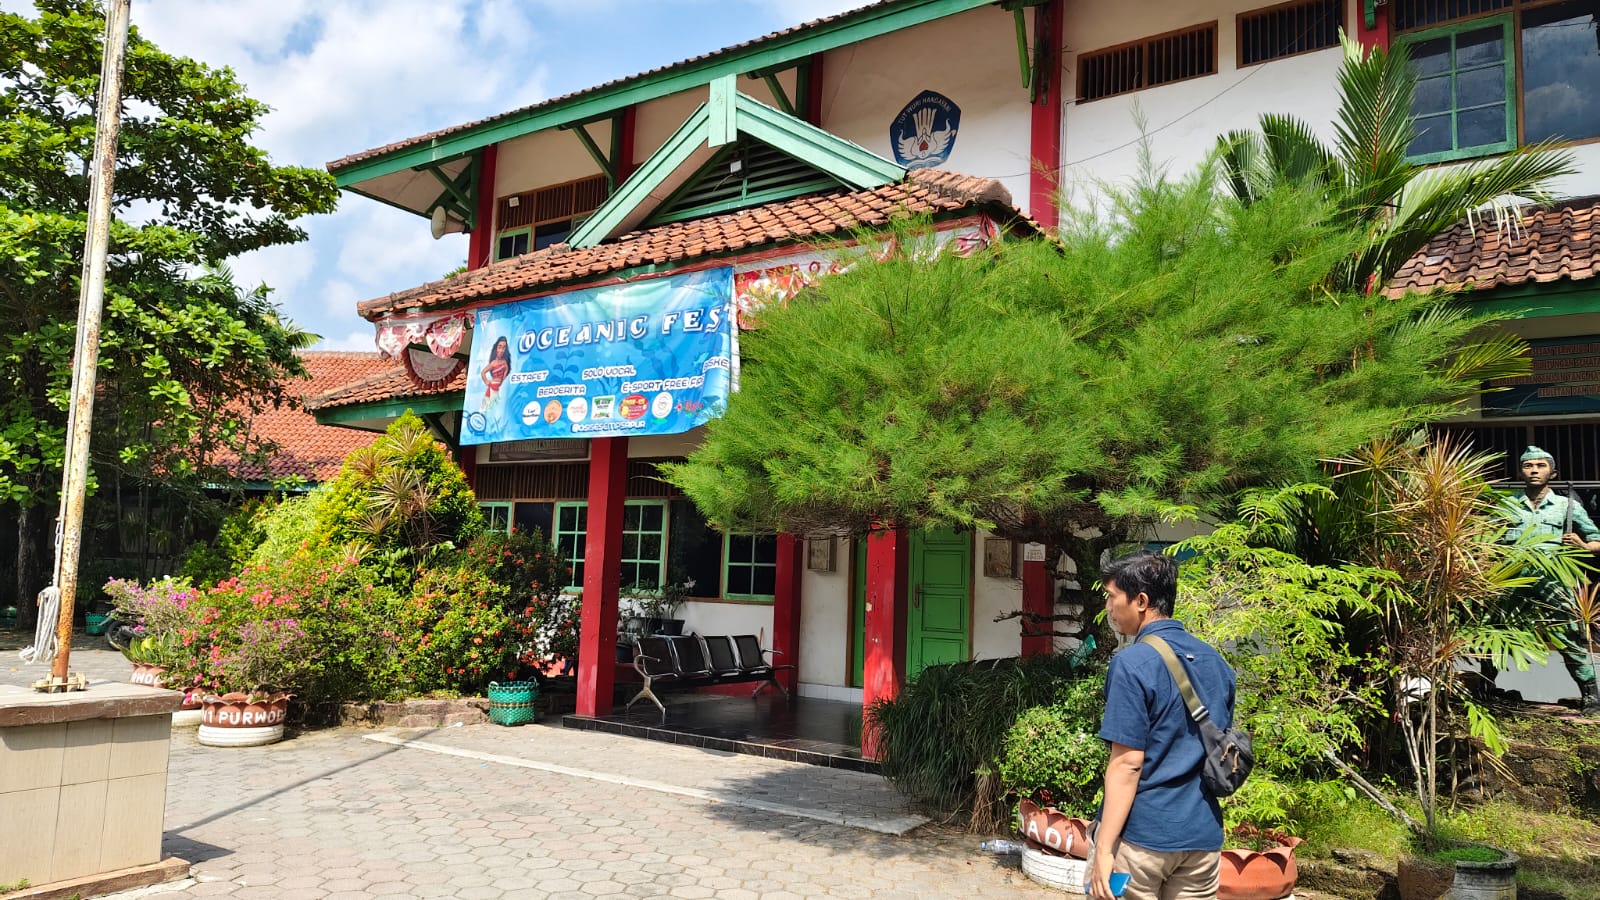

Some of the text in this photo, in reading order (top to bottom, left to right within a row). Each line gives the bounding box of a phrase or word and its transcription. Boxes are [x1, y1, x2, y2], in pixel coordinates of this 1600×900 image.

[518, 315, 648, 353] OCEANIC
[510, 370, 548, 383] ESTAFET
[583, 365, 636, 379] SOLO VOCAL
[622, 381, 662, 392] E-SPORT
[663, 378, 687, 389] FREE
